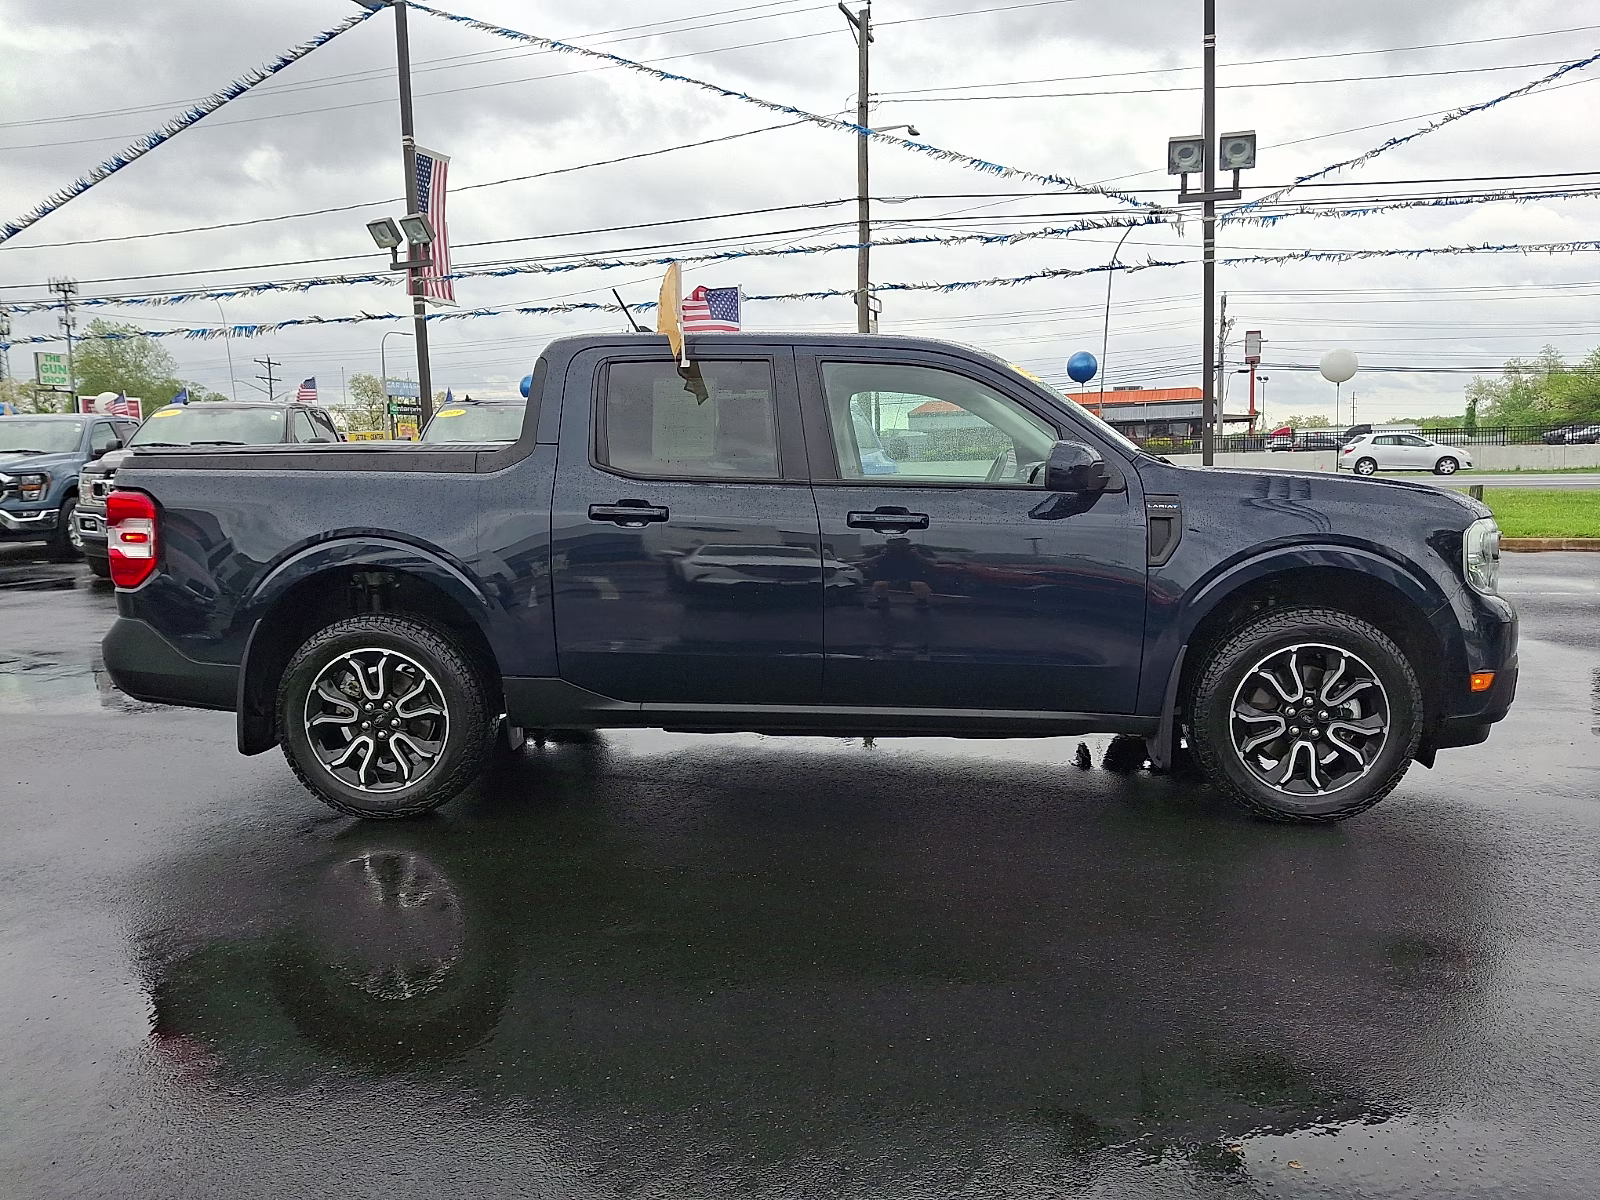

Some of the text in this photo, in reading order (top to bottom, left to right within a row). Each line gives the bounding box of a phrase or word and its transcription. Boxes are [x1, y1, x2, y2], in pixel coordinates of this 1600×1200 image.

[44, 354, 60, 362] THE
[40, 364, 67, 374] GUN
[42, 376, 66, 384] SHOP
[391, 405, 422, 414] enterpris
